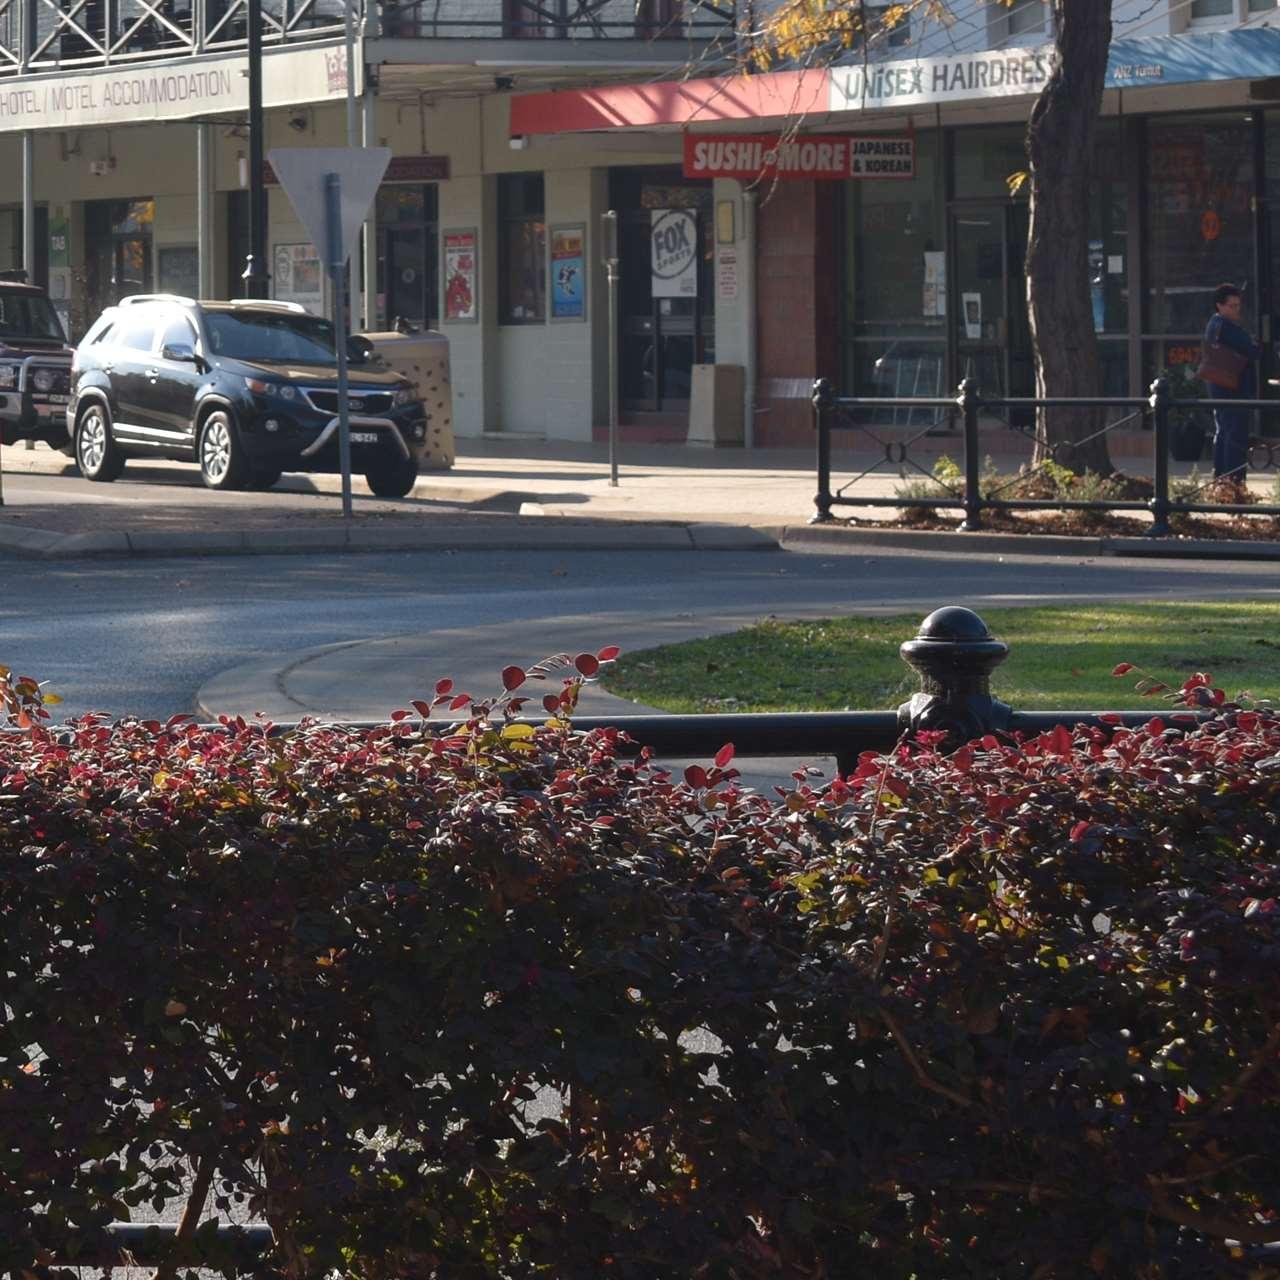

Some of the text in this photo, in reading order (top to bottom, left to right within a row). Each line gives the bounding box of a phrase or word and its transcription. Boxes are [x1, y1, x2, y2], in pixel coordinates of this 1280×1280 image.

[931, 54, 1048, 93] HAIRDRES
[1113, 64, 1132, 79] ANZ
[0, 89, 41, 117] HOTEL
[52, 84, 97, 112] MOTEL
[103, 68, 231, 107] ACCOMMODATION
[693, 142, 846, 171] SUSHI MORE
[852, 141, 911, 156] JAPANESE
[853, 158, 912, 173] & KOREAN
[51, 235, 66, 251] TAB
[654, 218, 690, 260] FOX
[656, 248, 692, 271] SPORTS
